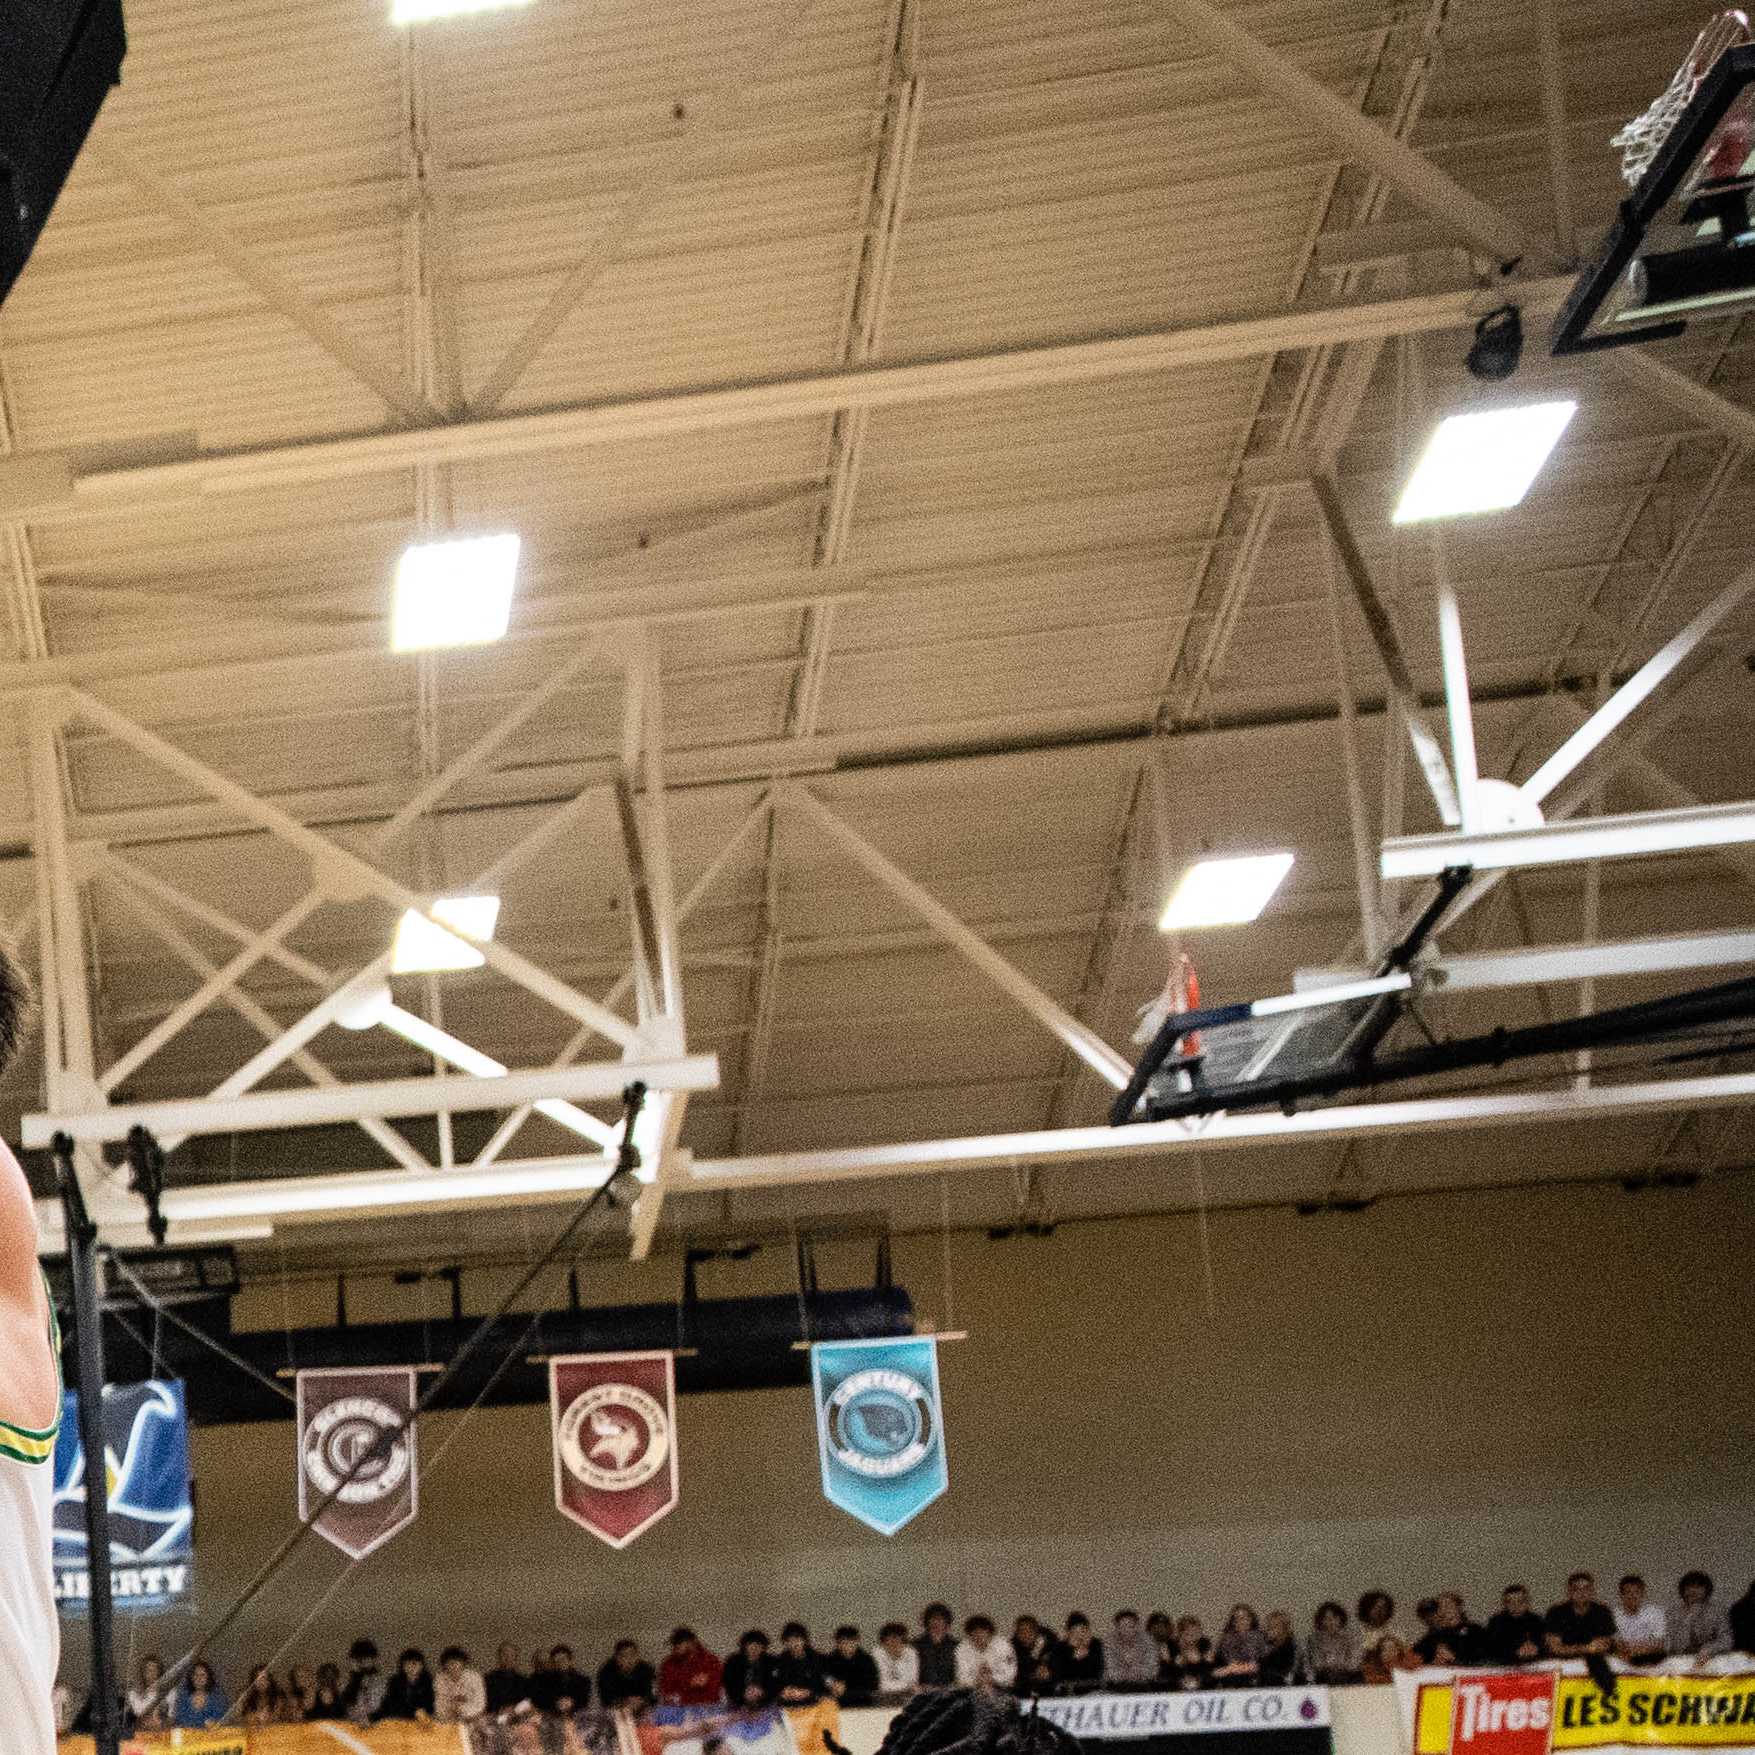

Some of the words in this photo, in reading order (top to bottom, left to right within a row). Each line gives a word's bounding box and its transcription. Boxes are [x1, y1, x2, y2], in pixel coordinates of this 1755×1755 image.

[1181, 1697, 1229, 1724] OIL
[1459, 1683, 1550, 1742] Tires
[1562, 1695, 1621, 1729] LES
[1627, 1691, 1755, 1728] SCHWA
